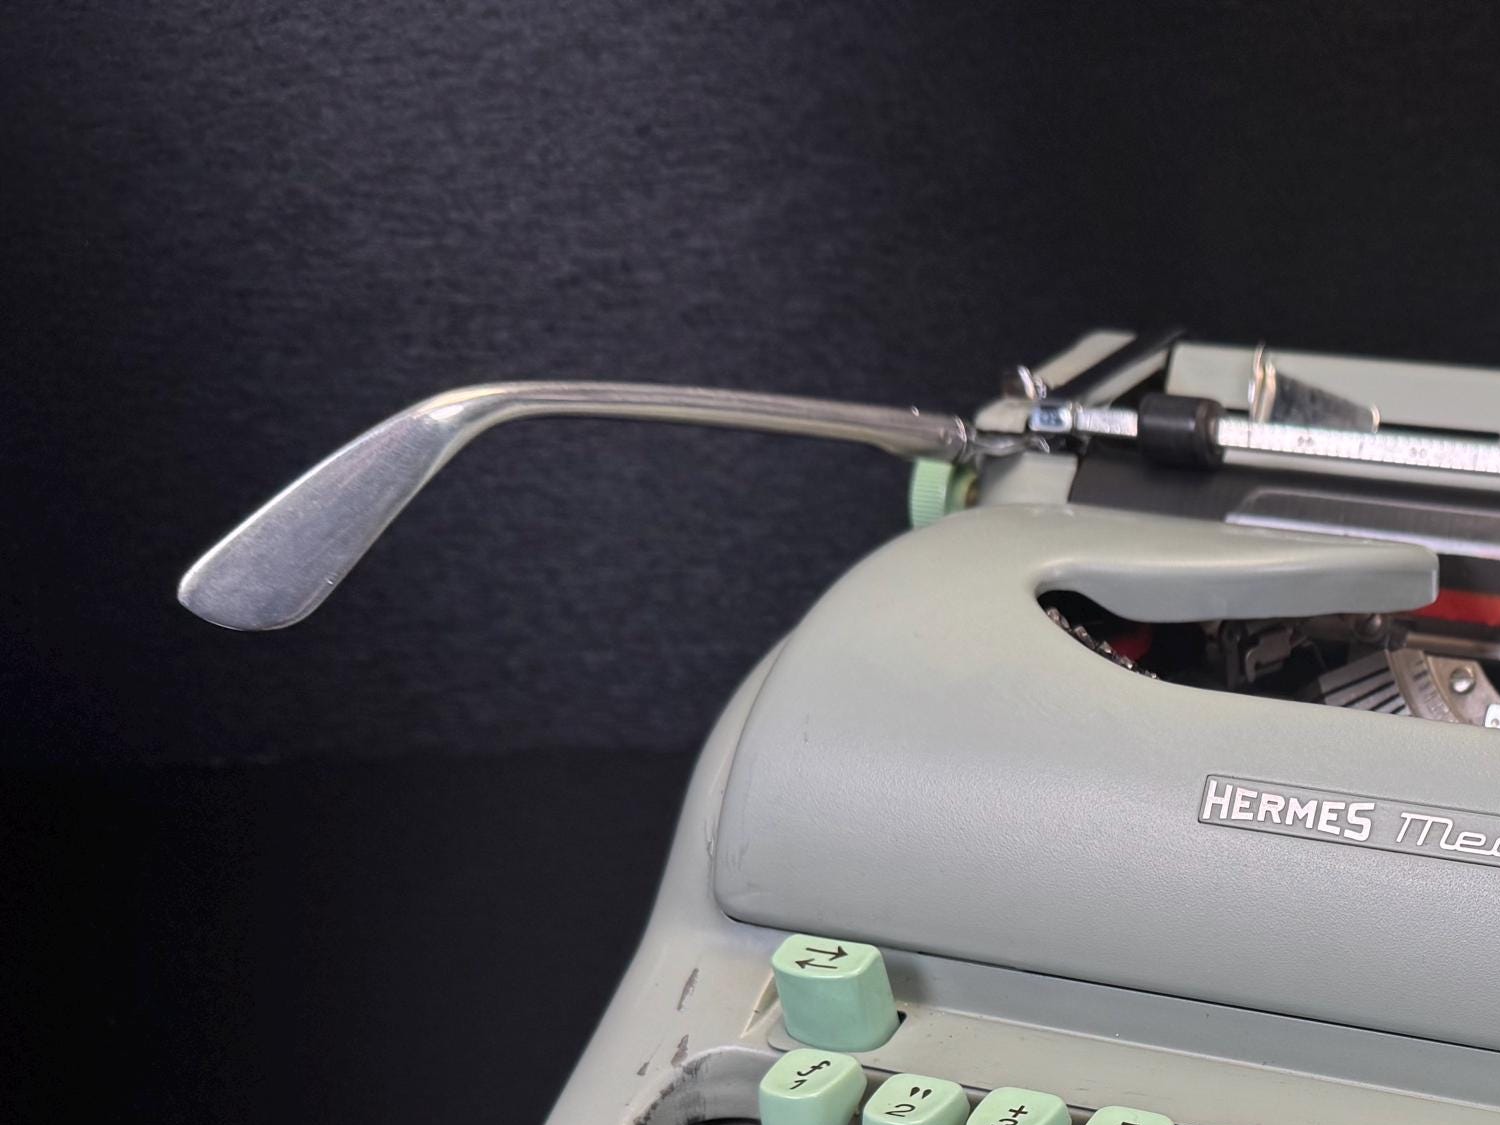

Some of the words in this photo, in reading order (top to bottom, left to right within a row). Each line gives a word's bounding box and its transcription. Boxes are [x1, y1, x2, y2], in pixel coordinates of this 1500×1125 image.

[1201, 779, 1376, 842] HERMES
[790, 1079, 807, 1090] 1
[885, 1104, 915, 1117] 2
[1009, 1105, 1028, 1118] +
